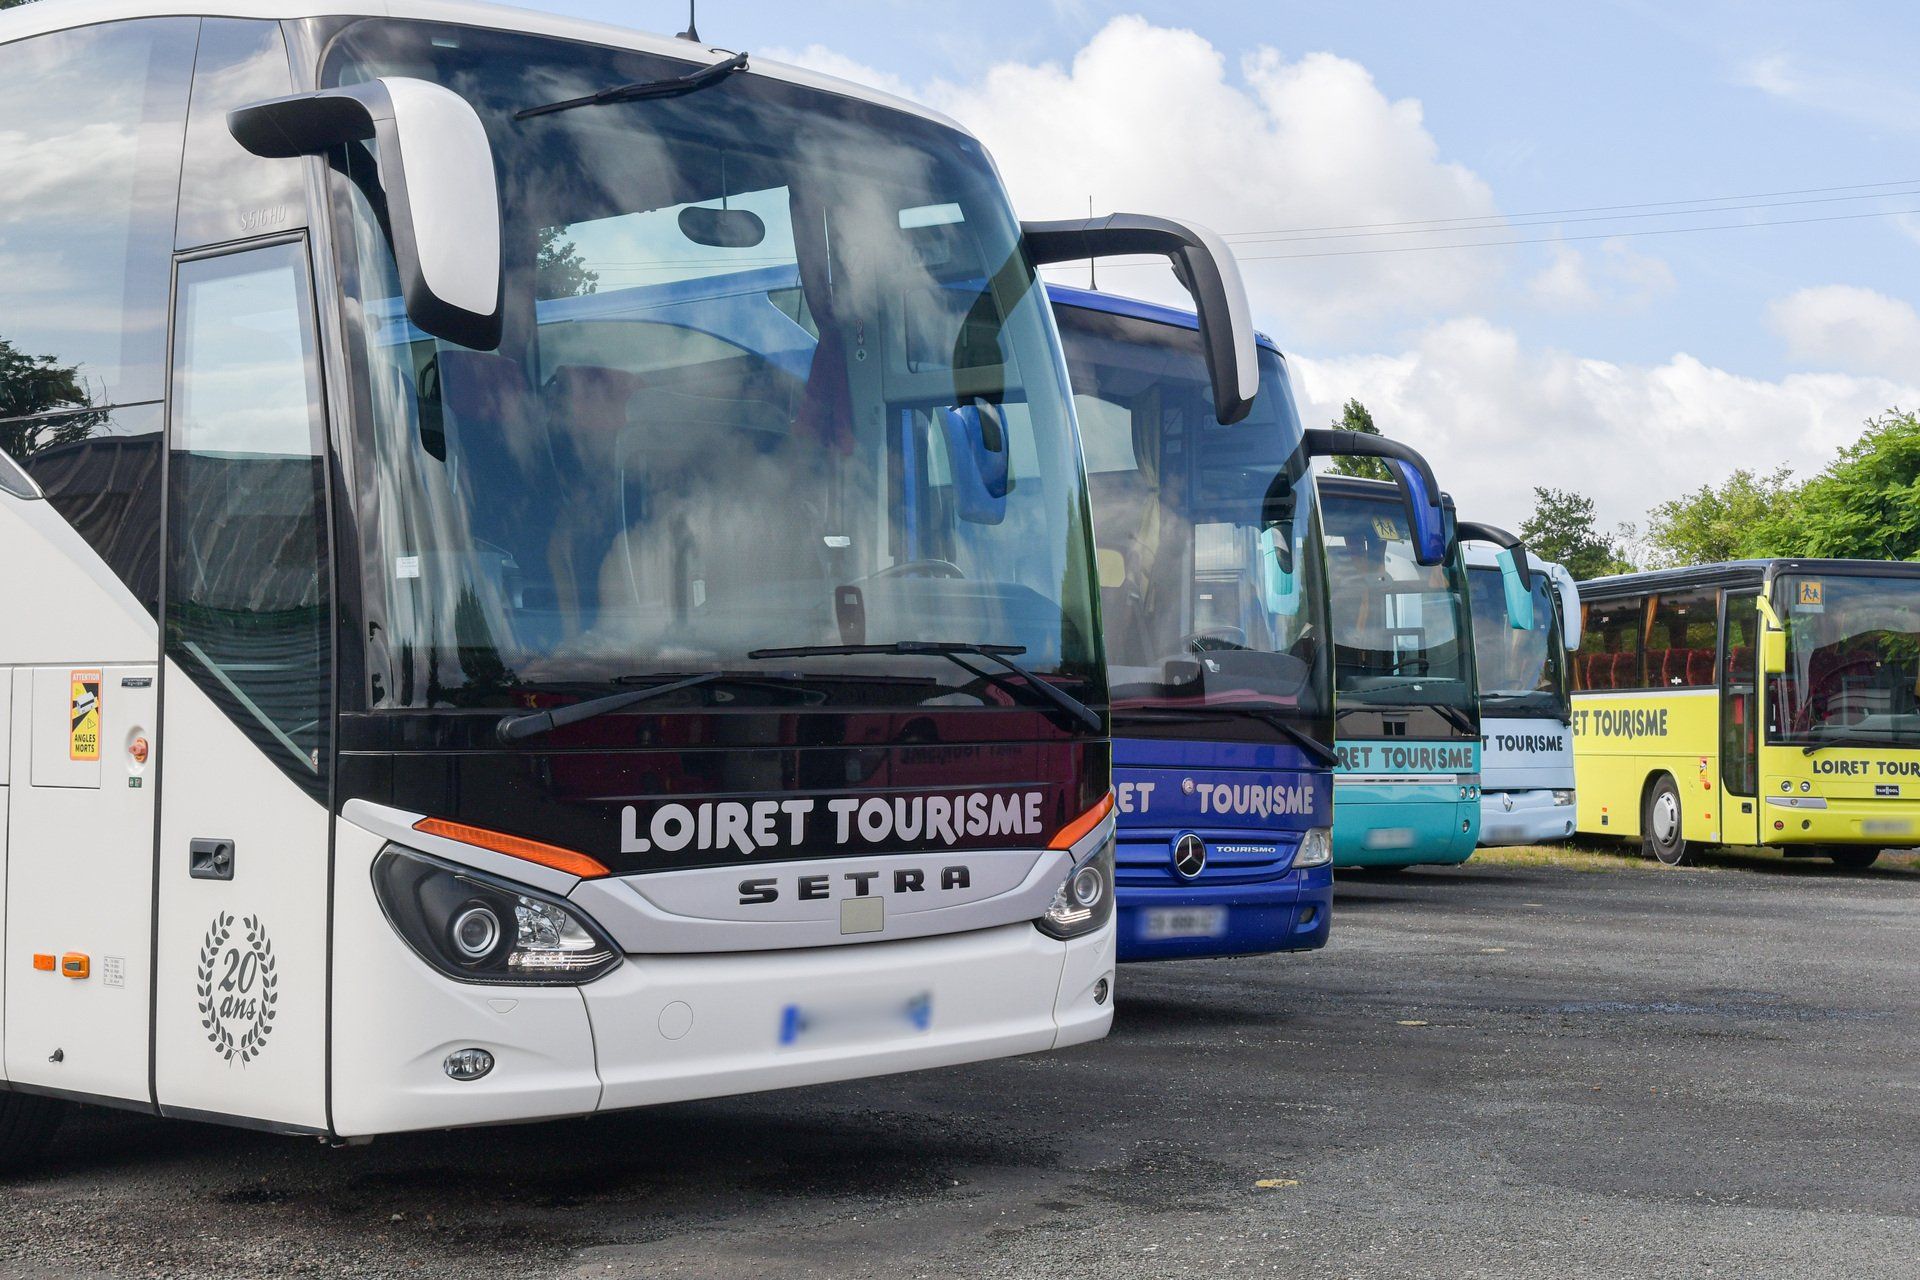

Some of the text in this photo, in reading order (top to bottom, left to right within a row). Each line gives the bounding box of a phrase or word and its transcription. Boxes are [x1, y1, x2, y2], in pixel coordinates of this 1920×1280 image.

[1593, 709, 1668, 740] TOURISME
[74, 733, 96, 743] ANGLES
[75, 744, 95, 753] MORTS
[1495, 734, 1564, 754] TOURISME
[1380, 747, 1473, 772] TOURISME
[1812, 760, 1920, 778] LOIRET TOUR
[1196, 783, 1314, 819] TOURISME
[620, 791, 1043, 855] LOIRET TOURISME
[1216, 846, 1277, 854] TOURISMO
[738, 864, 971, 905] SETRA
[217, 947, 258, 994] 20
[219, 994, 257, 1021] ans
